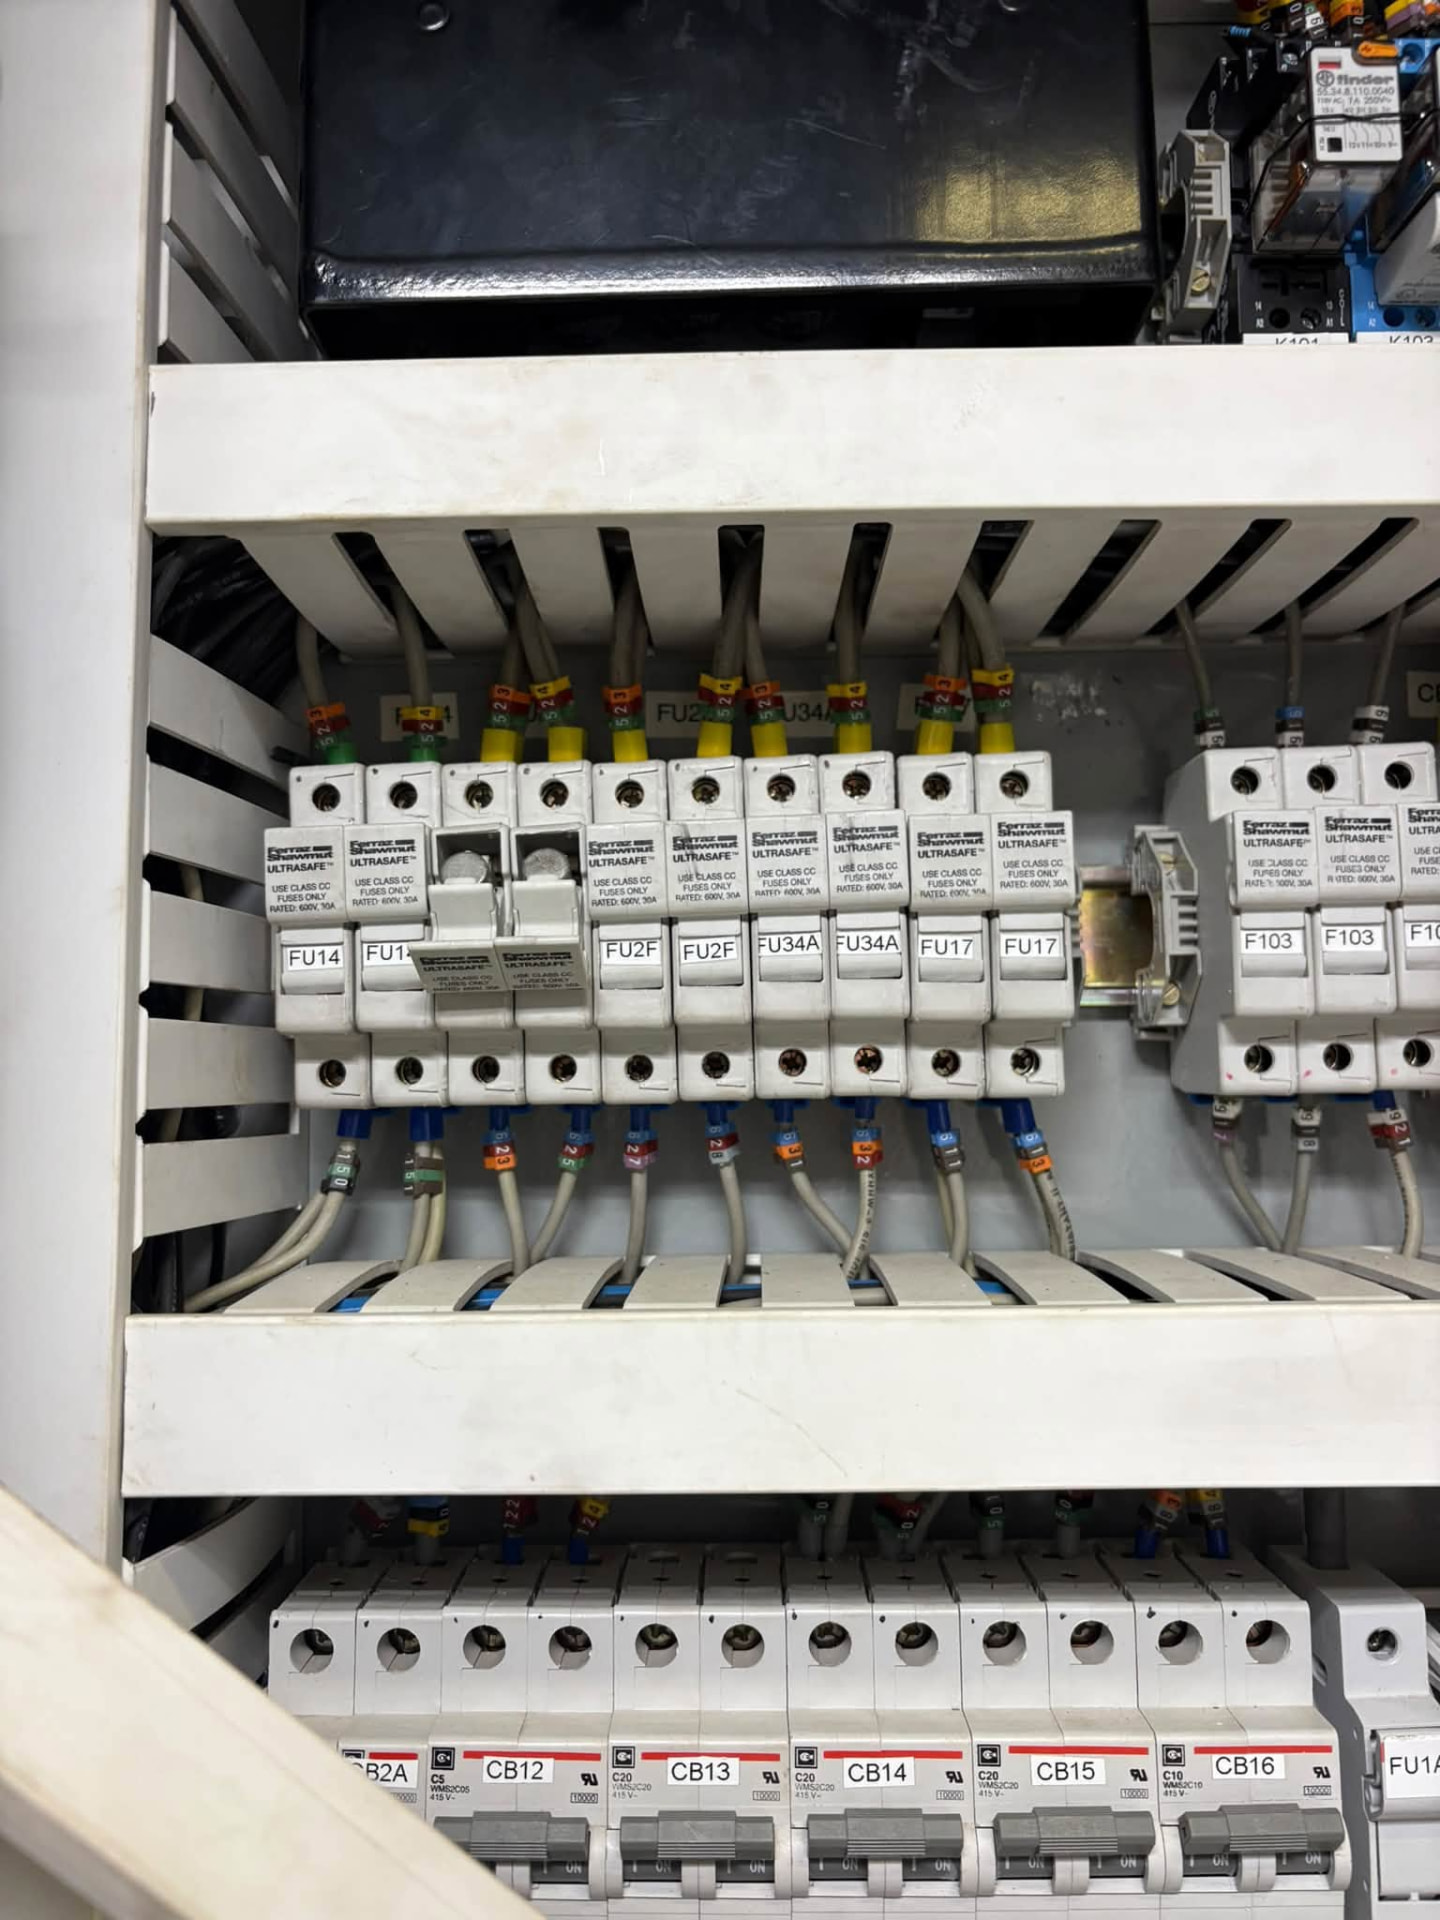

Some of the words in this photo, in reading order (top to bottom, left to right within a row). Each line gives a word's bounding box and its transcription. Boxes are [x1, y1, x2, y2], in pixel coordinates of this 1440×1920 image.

[1337, 75, 1394, 85] finder
[1243, 820, 1287, 828] Ferraz
[1325, 816, 1369, 824] Ferraz
[752, 831, 797, 840] Ferraz
[834, 826, 878, 835] Ferraz
[998, 828, 1065, 837] Shawmut
[673, 836, 717, 844] Ferraz
[752, 836, 819, 847] Shawmut
[834, 831, 900, 842] Shawmut
[918, 832, 962, 841] Ferraz
[350, 840, 394, 848] Ferraz
[589, 840, 633, 849] Ferraz
[673, 840, 740, 851] Shawmut
[917, 837, 984, 848] Shawmut
[267, 846, 311, 855] Ferraz
[350, 844, 417, 855] Shawmut
[588, 845, 655, 856] Shawmut
[267, 851, 334, 862] Shawmut
[1330, 855, 1348, 863] USE
[1349, 855, 1376, 863] CLASS
[1377, 855, 1390, 863] CC
[839, 864, 857, 873] USE
[857, 862, 884, 872] CLASS
[885, 862, 898, 870] CC
[1003, 860, 1020, 869] USE
[1021, 860, 1049, 869] CLASS
[1051, 859, 1063, 868] CC
[1248, 859, 1266, 867] USE
[1295, 859, 1308, 867] CC
[757, 869, 775, 878] USE
[775, 868, 802, 877] CLASS
[804, 867, 816, 875] CC
[922, 869, 940, 879] USE
[940, 868, 967, 877] CLASS
[969, 867, 981, 876] CC
[1008, 870, 1035, 878] FUSES
[1036, 869, 1059, 878] ONLY
[1281, 869, 1304, 877] ONLY
[1363, 865, 1386, 873] ONLY
[355, 878, 372, 887] USE
[373, 876, 400, 886] CLASS
[401, 876, 414, 884] CC
[593, 878, 611, 887] USE
[611, 877, 638, 886] CLASS
[640, 876, 652, 885] CC
[678, 873, 695, 882] USE
[696, 872, 723, 881] CLASS
[724, 871, 737, 880] CC
[844, 873, 871, 883] FUSES
[872, 872, 894, 881] ONLY
[272, 884, 289, 893] USE
[290, 882, 317, 892] CLASS
[318, 882, 331, 890] CC
[683, 883, 710, 892] FUSES
[711, 881, 733, 891] ONLY
[762, 879, 789, 888] FUSES
[790, 877, 812, 887] ONLY
[928, 879, 955, 888] FUSES
[955, 877, 977, 887] ONLY
[360, 887, 387, 897] FUSES
[388, 885, 410, 895] ONLY
[599, 888, 626, 897] FUSES
[626, 886, 648, 896] ONLY
[277, 893, 304, 903] FUSES
[305, 892, 327, 902] ONLY
[837, 933, 900, 952] FU34A
[1244, 933, 1293, 950] F103
[1325, 929, 1375, 946] F103
[606, 942, 658, 959] FU2F
[758, 936, 820, 954] FU34A
[920, 938, 974, 956] FU17
[1004, 938, 1057, 956] FU17
[682, 941, 735, 961] FU2F
[289, 949, 341, 967] FU14
[487, 1760, 544, 1780] CB12
[671, 1762, 730, 1781] CB13
[1037, 1762, 1095, 1781] CB15
[1215, 1756, 1275, 1776] CB16
[612, 1773, 632, 1782] C20
[795, 1773, 815, 1782] C20
[848, 1763, 906, 1782] CB14
[978, 1770, 999, 1780] C20
[1163, 1771, 1183, 1781] C10
[431, 1774, 445, 1784] C5
[430, 1785, 470, 1793] WMS2C05
[612, 1783, 652, 1792] WMS2C20
[795, 1784, 835, 1792] WMS2C20
[978, 1782, 1019, 1790] WMS2C20
[1120, 1856, 1137, 1868] ON
[1305, 1852, 1322, 1864] ON
[566, 1861, 582, 1873] ON
[749, 1861, 765, 1873] ON
[935, 1859, 951, 1871] ON
